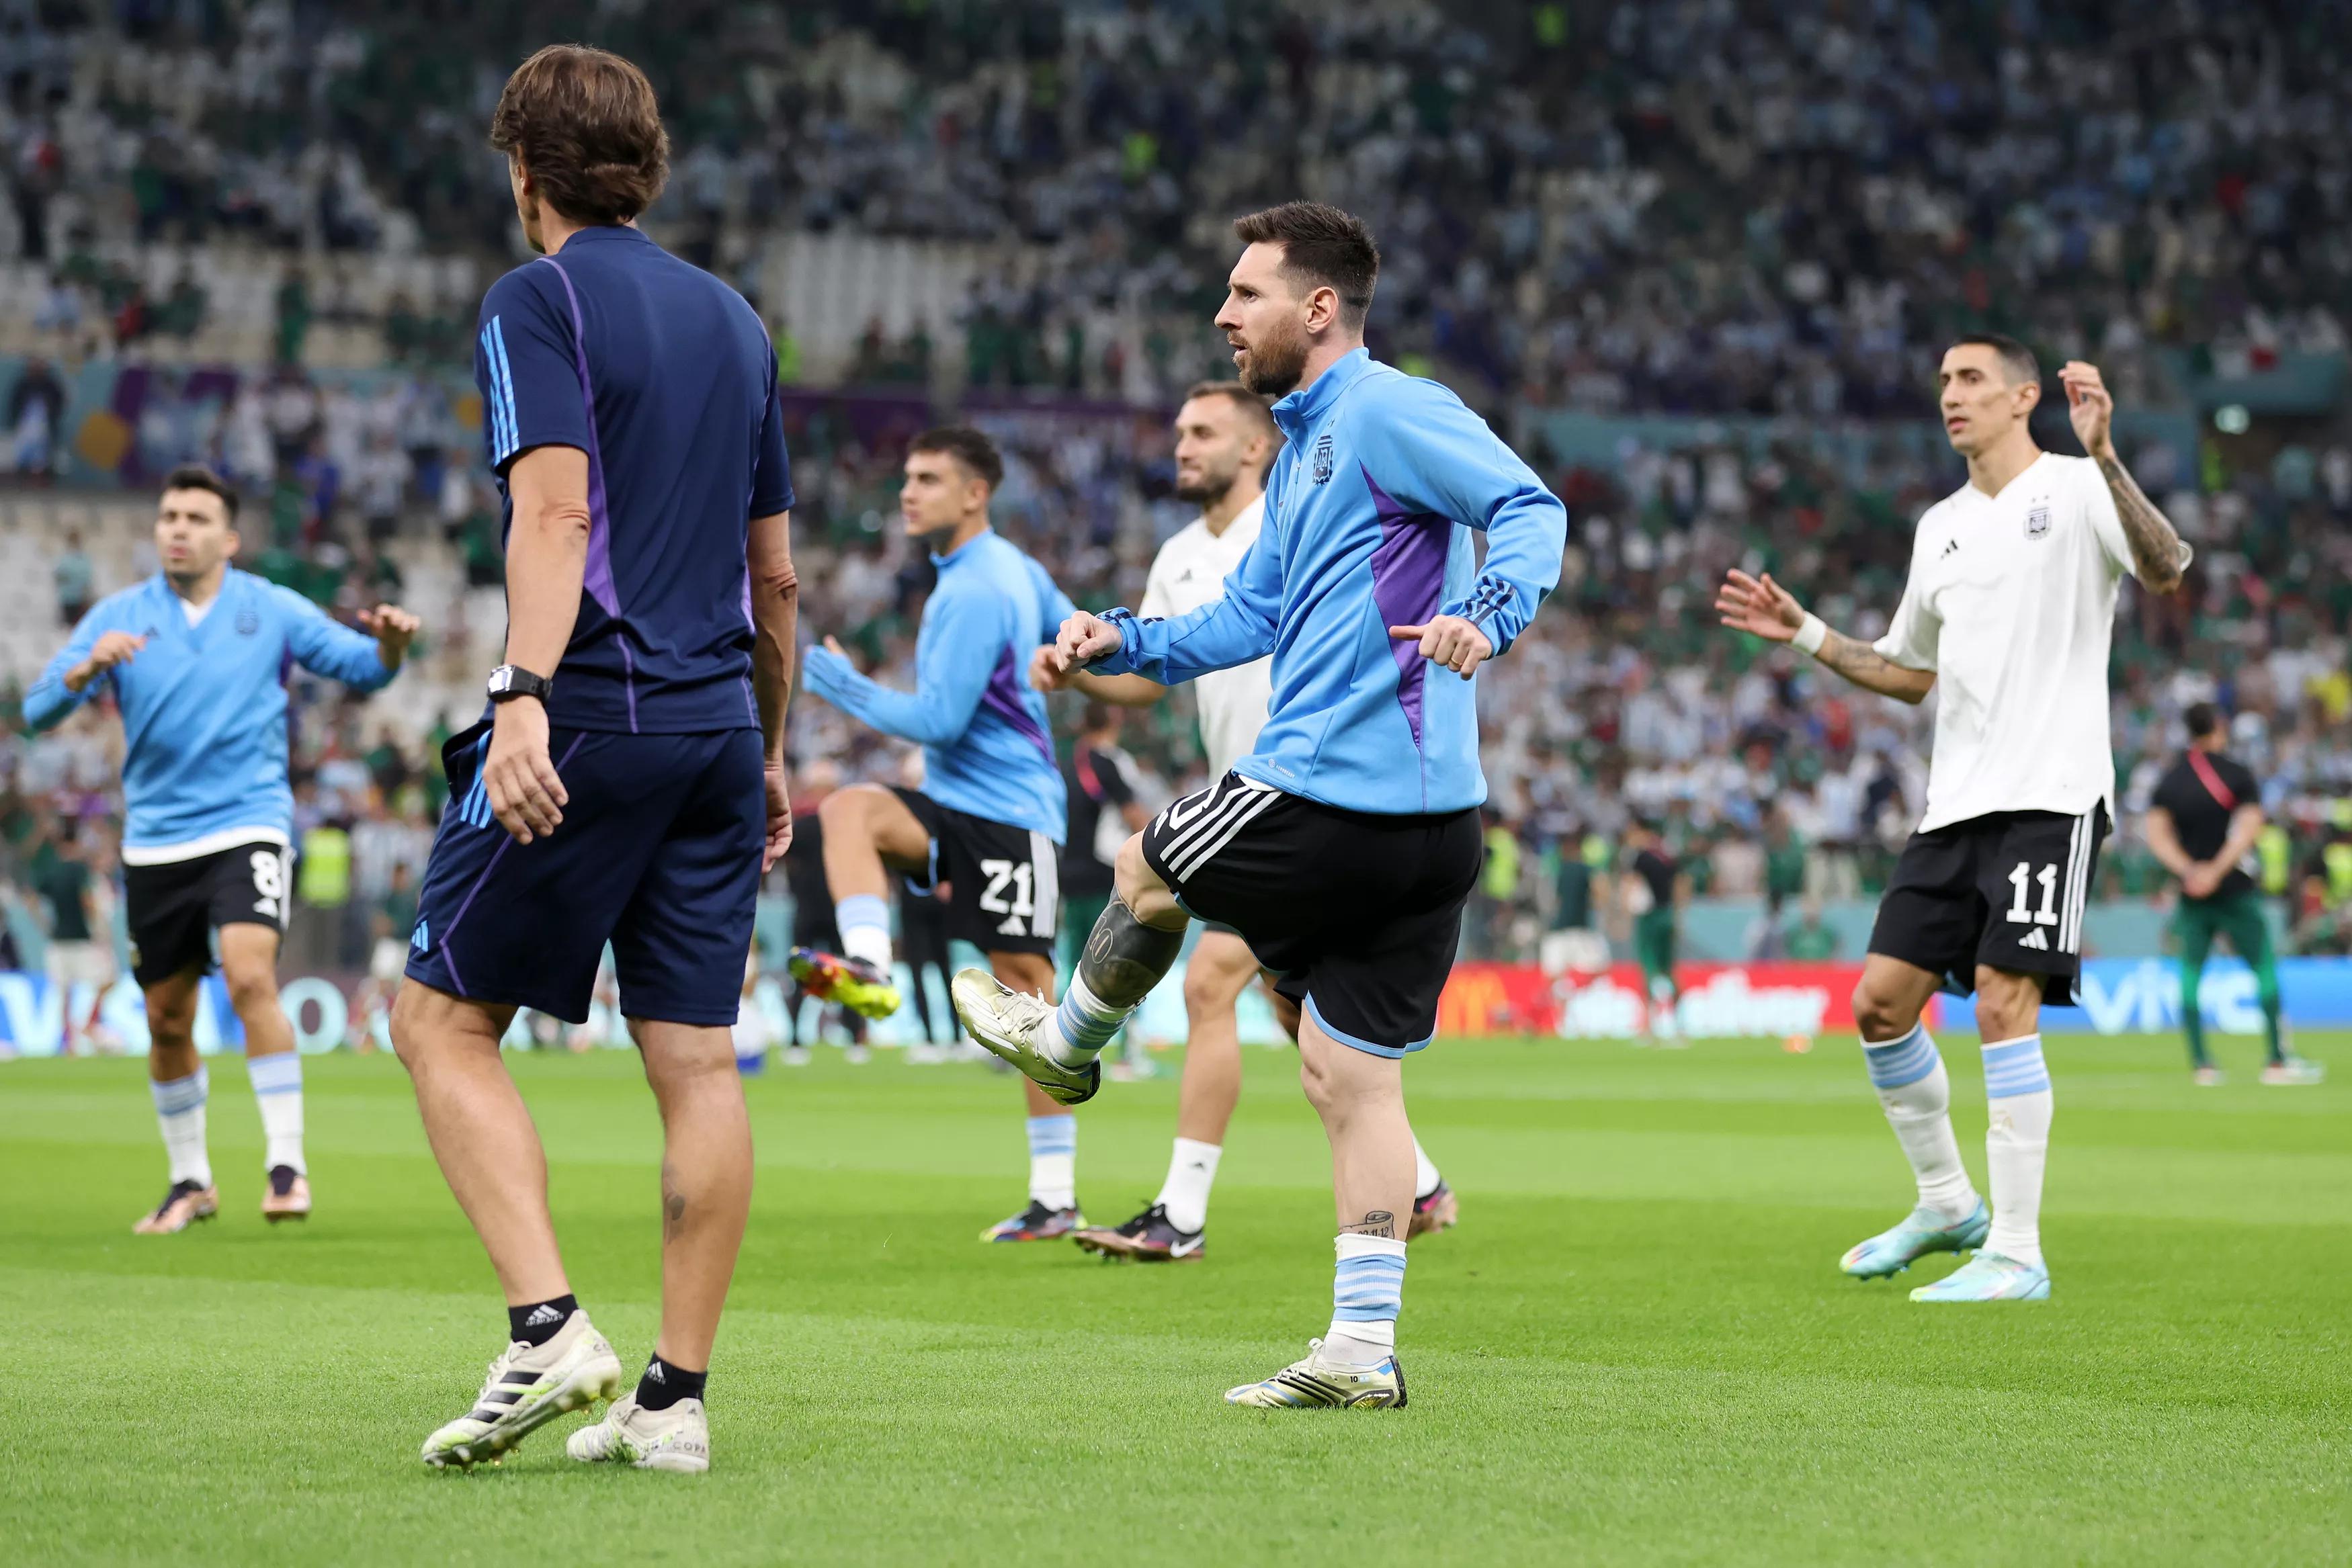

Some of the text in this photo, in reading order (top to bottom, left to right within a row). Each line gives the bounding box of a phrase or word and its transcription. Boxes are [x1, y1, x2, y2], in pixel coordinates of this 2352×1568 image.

[249, 850, 283, 900] 8
[979, 859, 1034, 917] 21
[2006, 861, 2058, 926] 11
